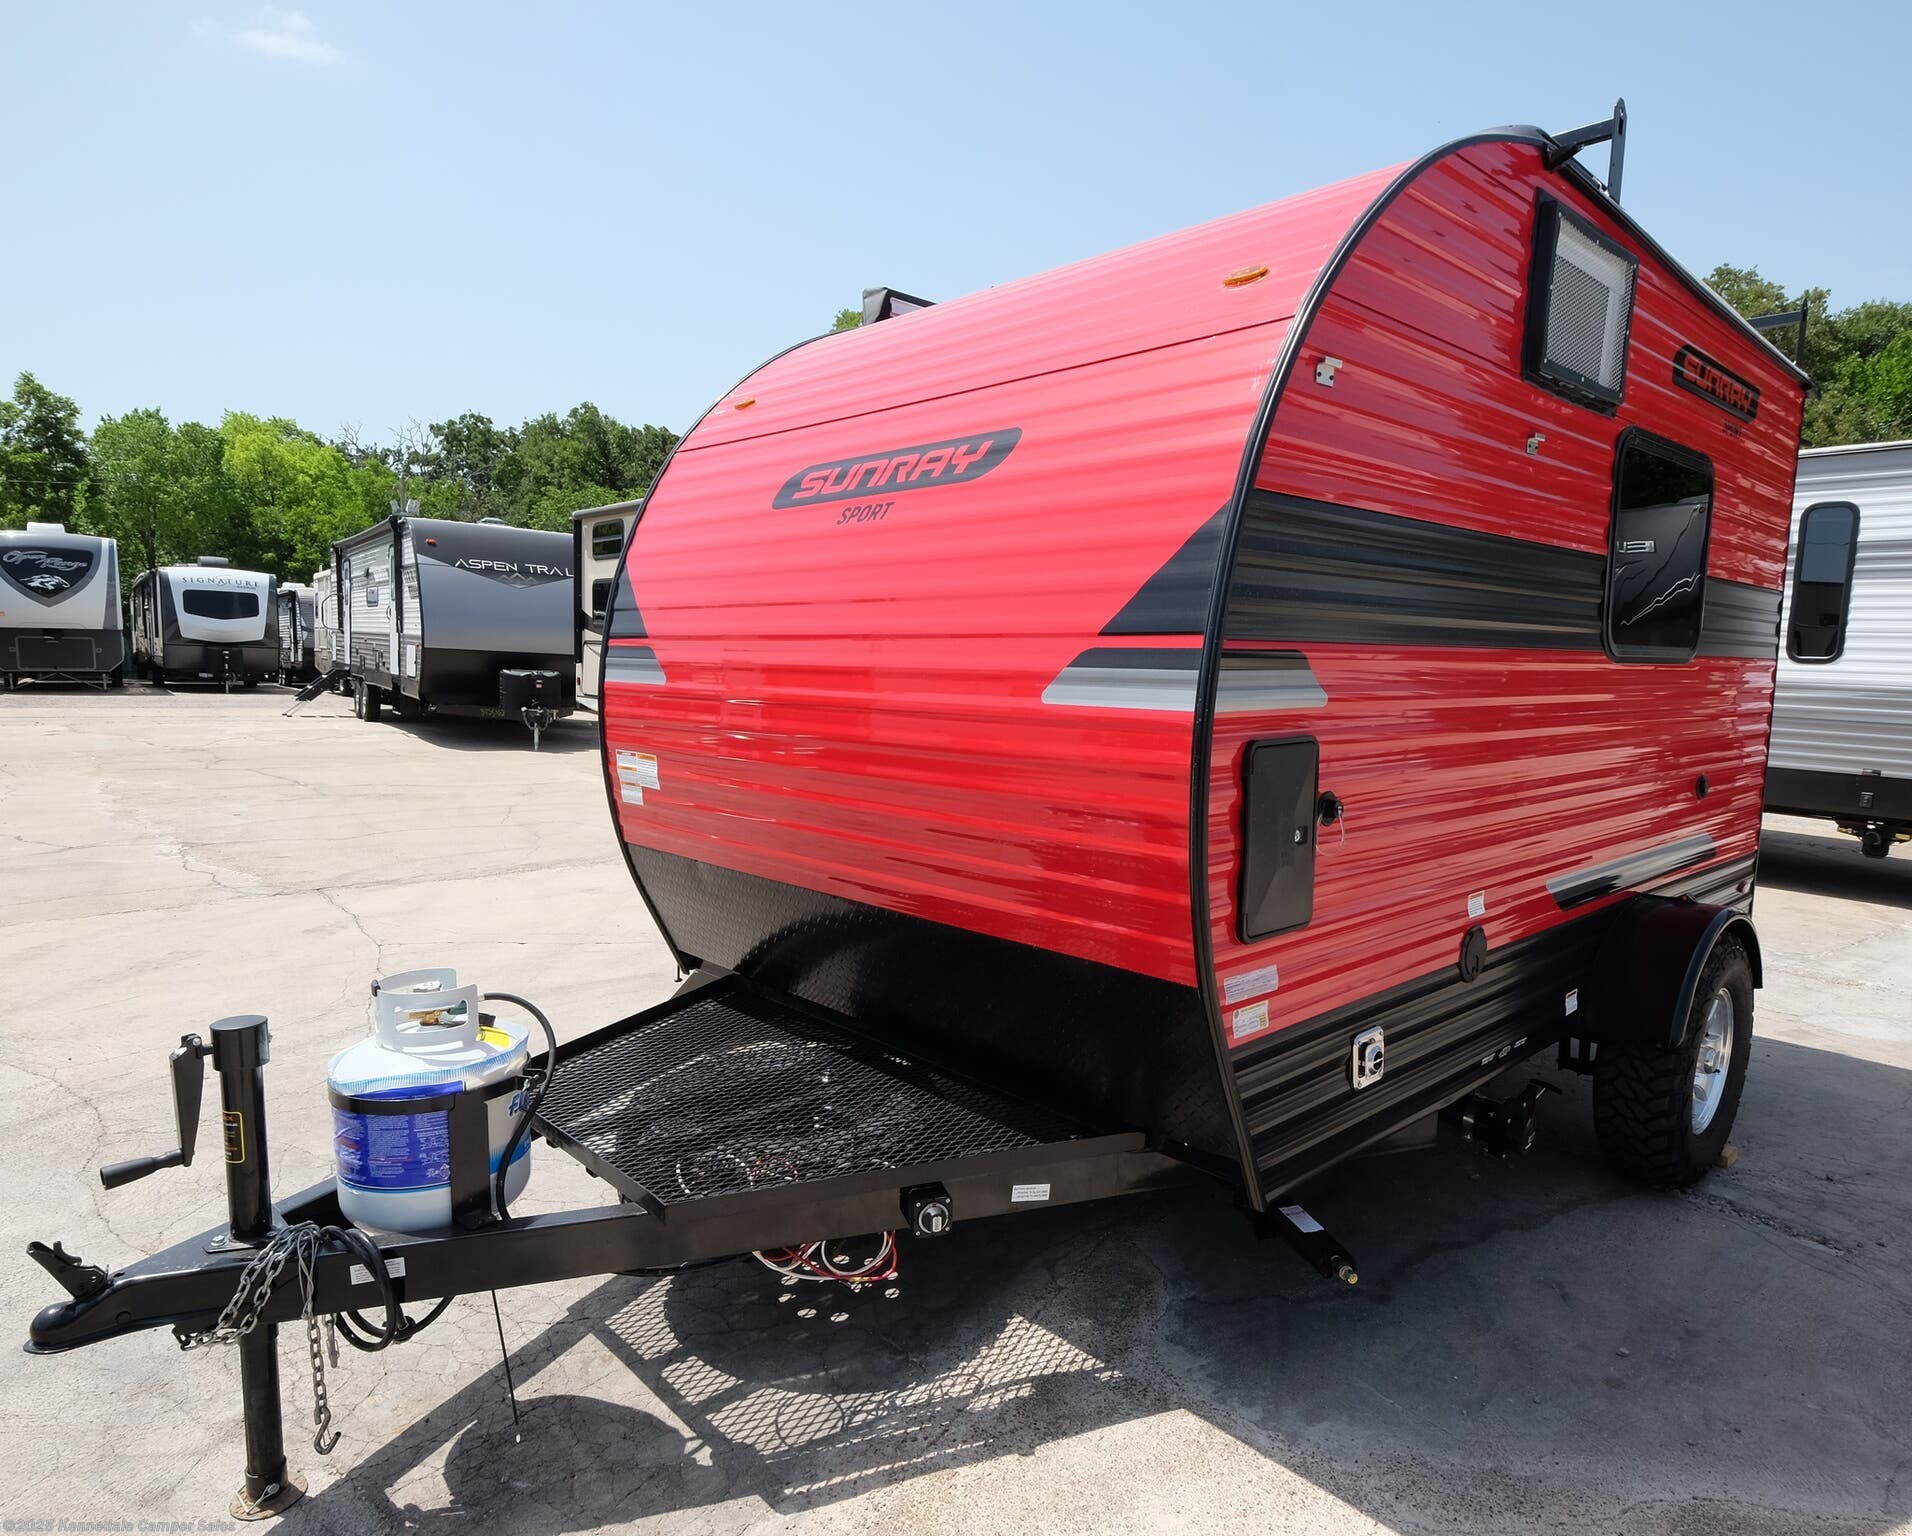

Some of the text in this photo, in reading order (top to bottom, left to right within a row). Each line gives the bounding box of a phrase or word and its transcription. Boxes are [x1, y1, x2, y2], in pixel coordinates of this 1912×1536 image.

[791, 440, 995, 500] SUNRAY
[836, 502, 895, 526] SPORT
[455, 558, 519, 573] ASPEN
